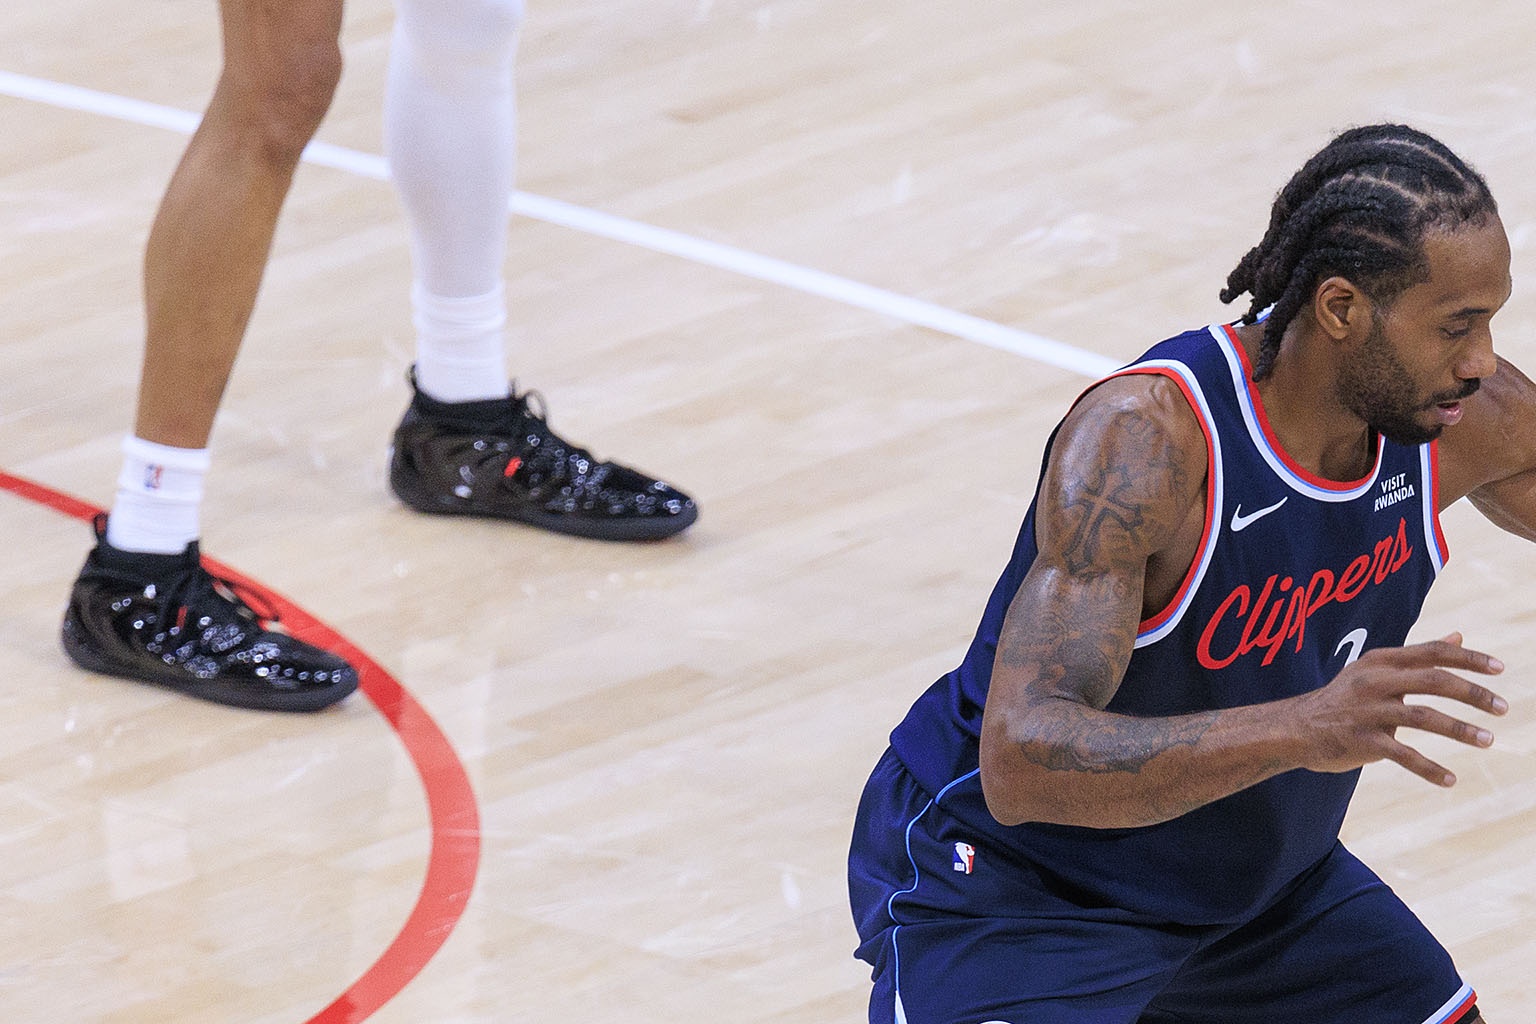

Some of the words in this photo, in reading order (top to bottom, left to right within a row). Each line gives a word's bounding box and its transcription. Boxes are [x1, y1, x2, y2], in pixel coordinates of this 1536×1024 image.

[1380, 473, 1406, 494] VISIT
[1374, 484, 1415, 512] RWANDA
[1197, 517, 1414, 669] Clippers
